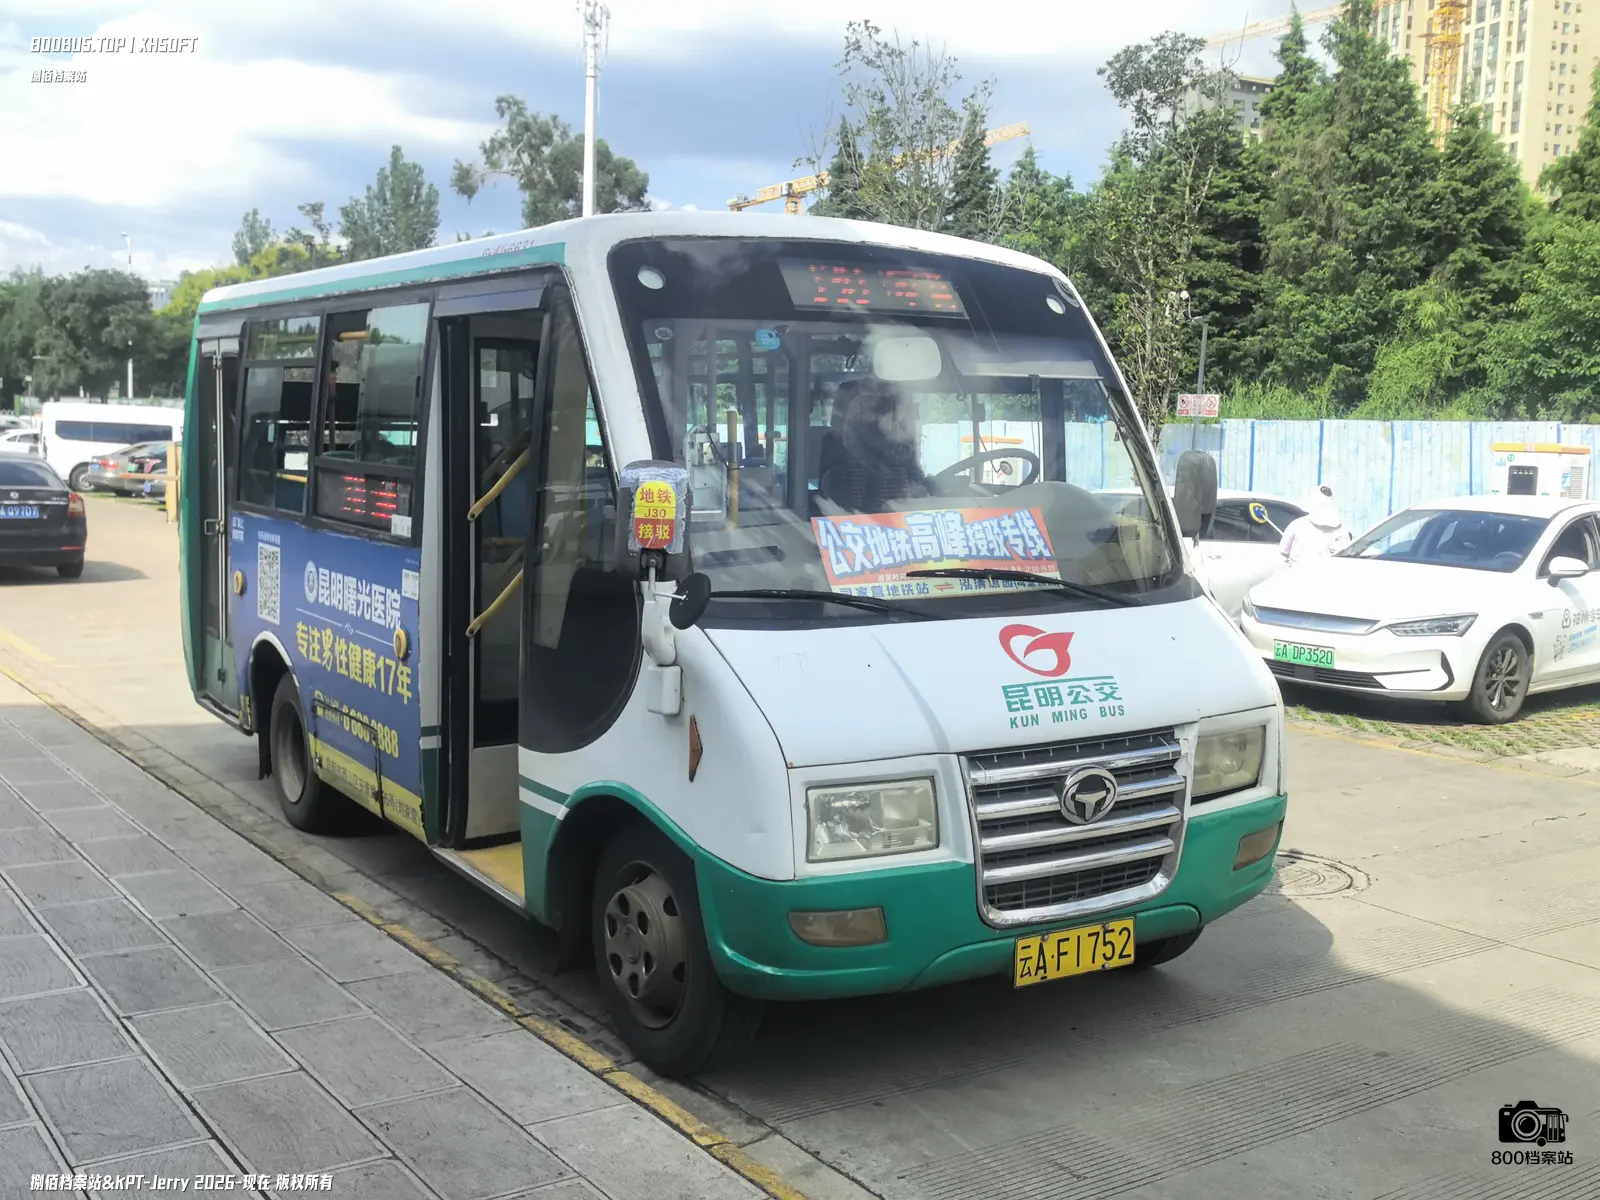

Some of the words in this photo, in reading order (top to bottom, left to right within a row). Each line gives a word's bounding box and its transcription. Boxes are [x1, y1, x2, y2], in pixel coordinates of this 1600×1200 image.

[640, 488, 672, 504] 地铁
[644, 508, 667, 518] J30
[638, 523, 670, 540] 接驳
[817, 509, 1053, 579] 公交地铁高峰接驳专线
[318, 567, 401, 629] 昆明曙光医院
[296, 621, 413, 705] 专注男性健康17年
[1002, 677, 1123, 713] 昆明公交
[1009, 714, 1040, 729] KUN
[1052, 708, 1088, 724] MING
[1099, 705, 1125, 718] BUS
